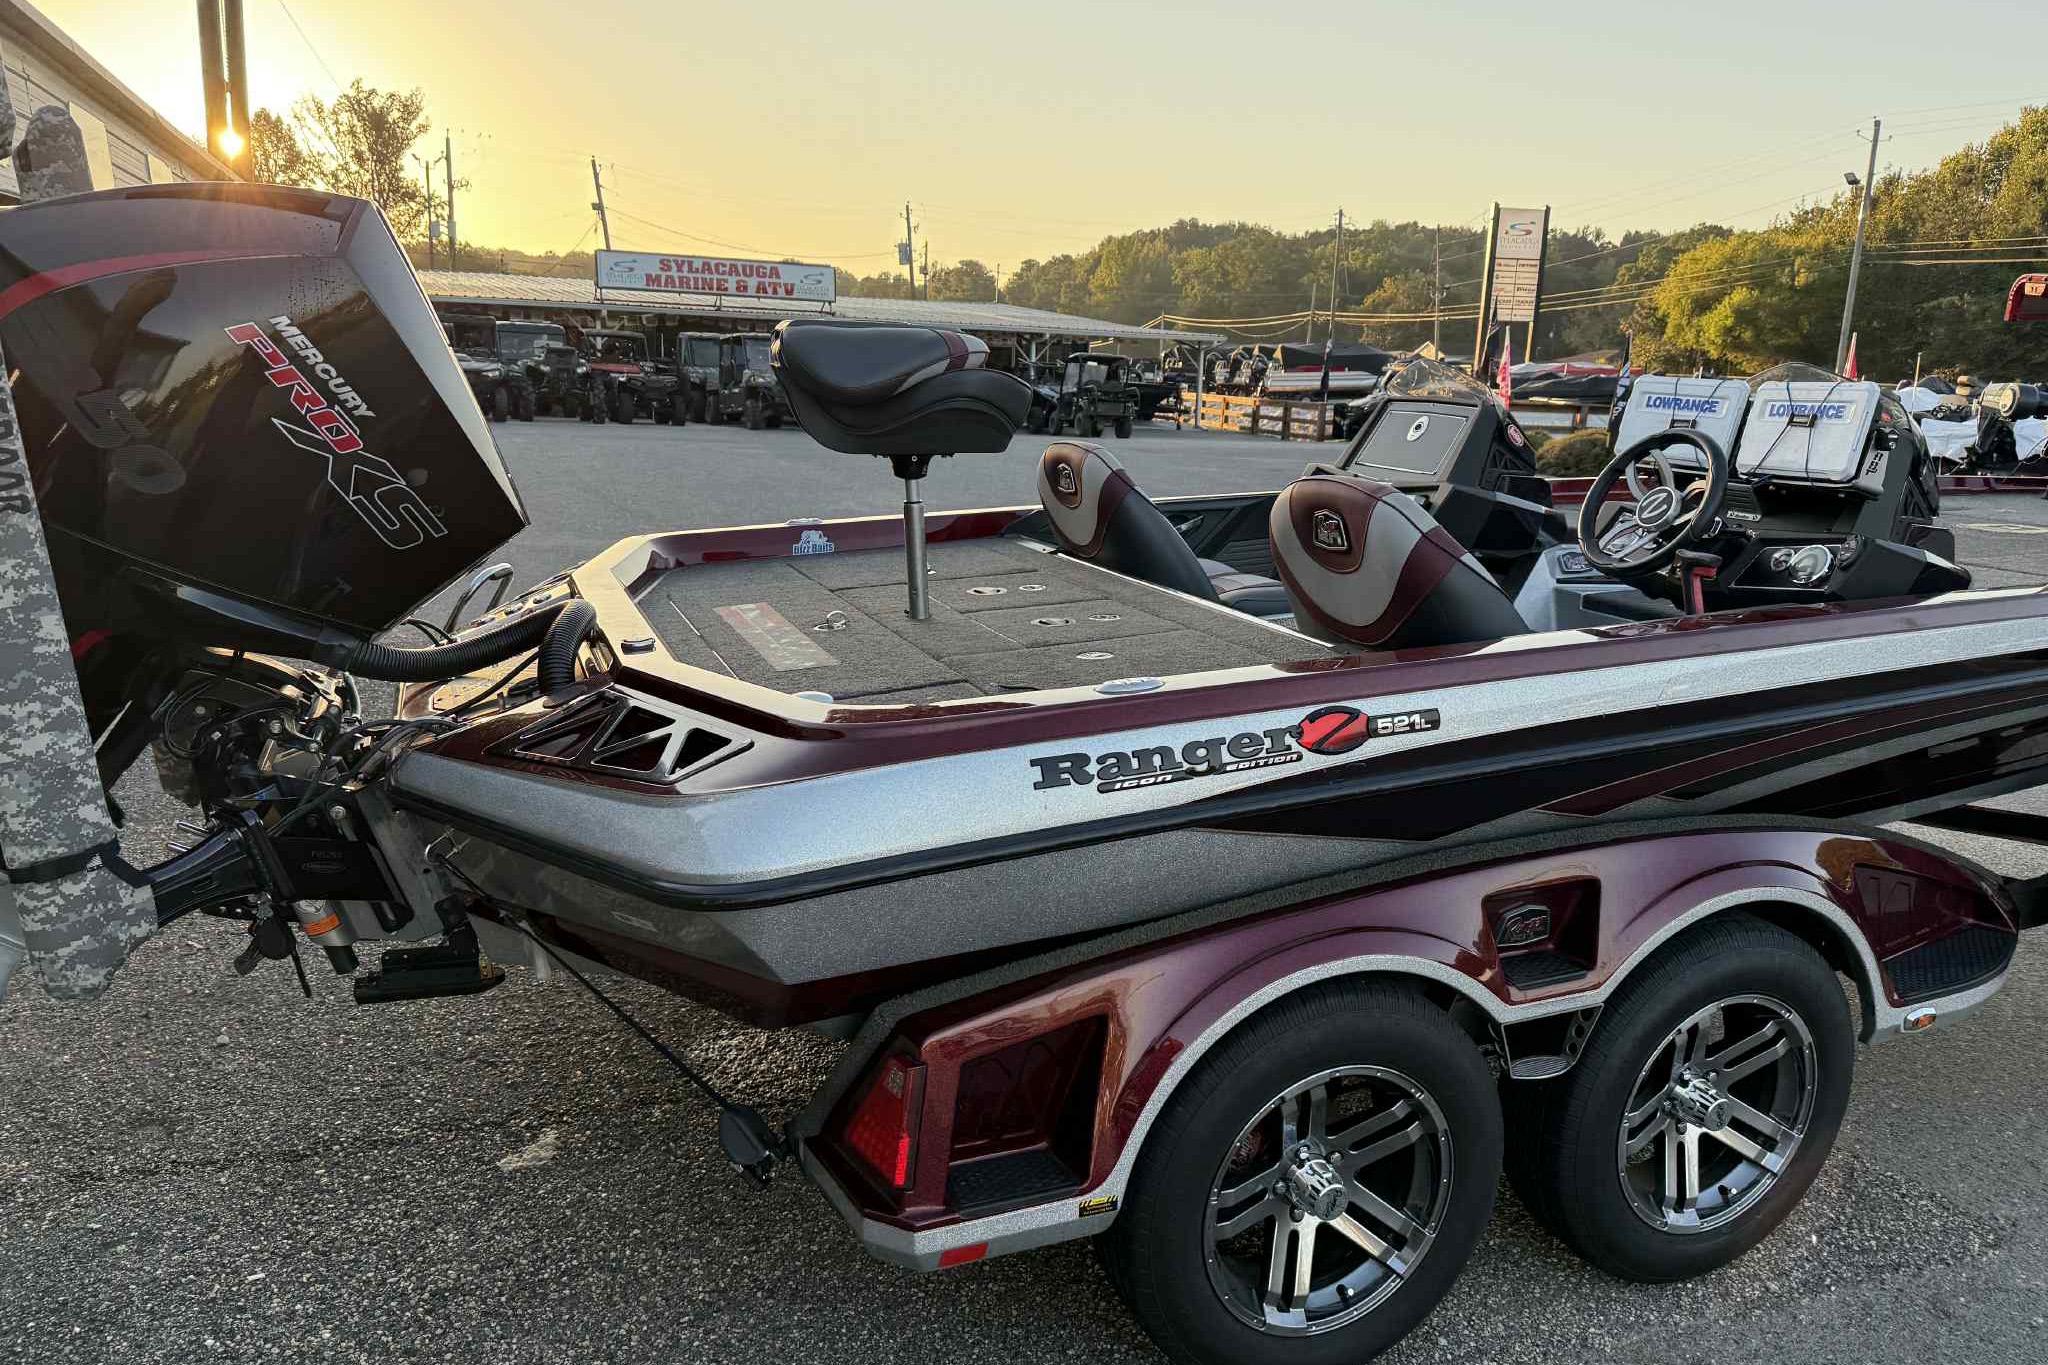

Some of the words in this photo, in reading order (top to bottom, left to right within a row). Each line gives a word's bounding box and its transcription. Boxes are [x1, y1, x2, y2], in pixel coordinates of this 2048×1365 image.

[645, 273, 729, 293] MARINE
[736, 280, 749, 294] &
[756, 281, 796, 297] ATV
[658, 258, 781, 279] SYLACAUGA
[224, 322, 363, 453] PRO
[268, 315, 376, 418] MERCURY
[1645, 395, 1720, 413] LOWRANCE
[1768, 403, 1847, 419] LOWRANCE
[271, 404, 448, 550] XS
[1030, 724, 1302, 790] Ranger
[1376, 711, 1432, 735] 521L
